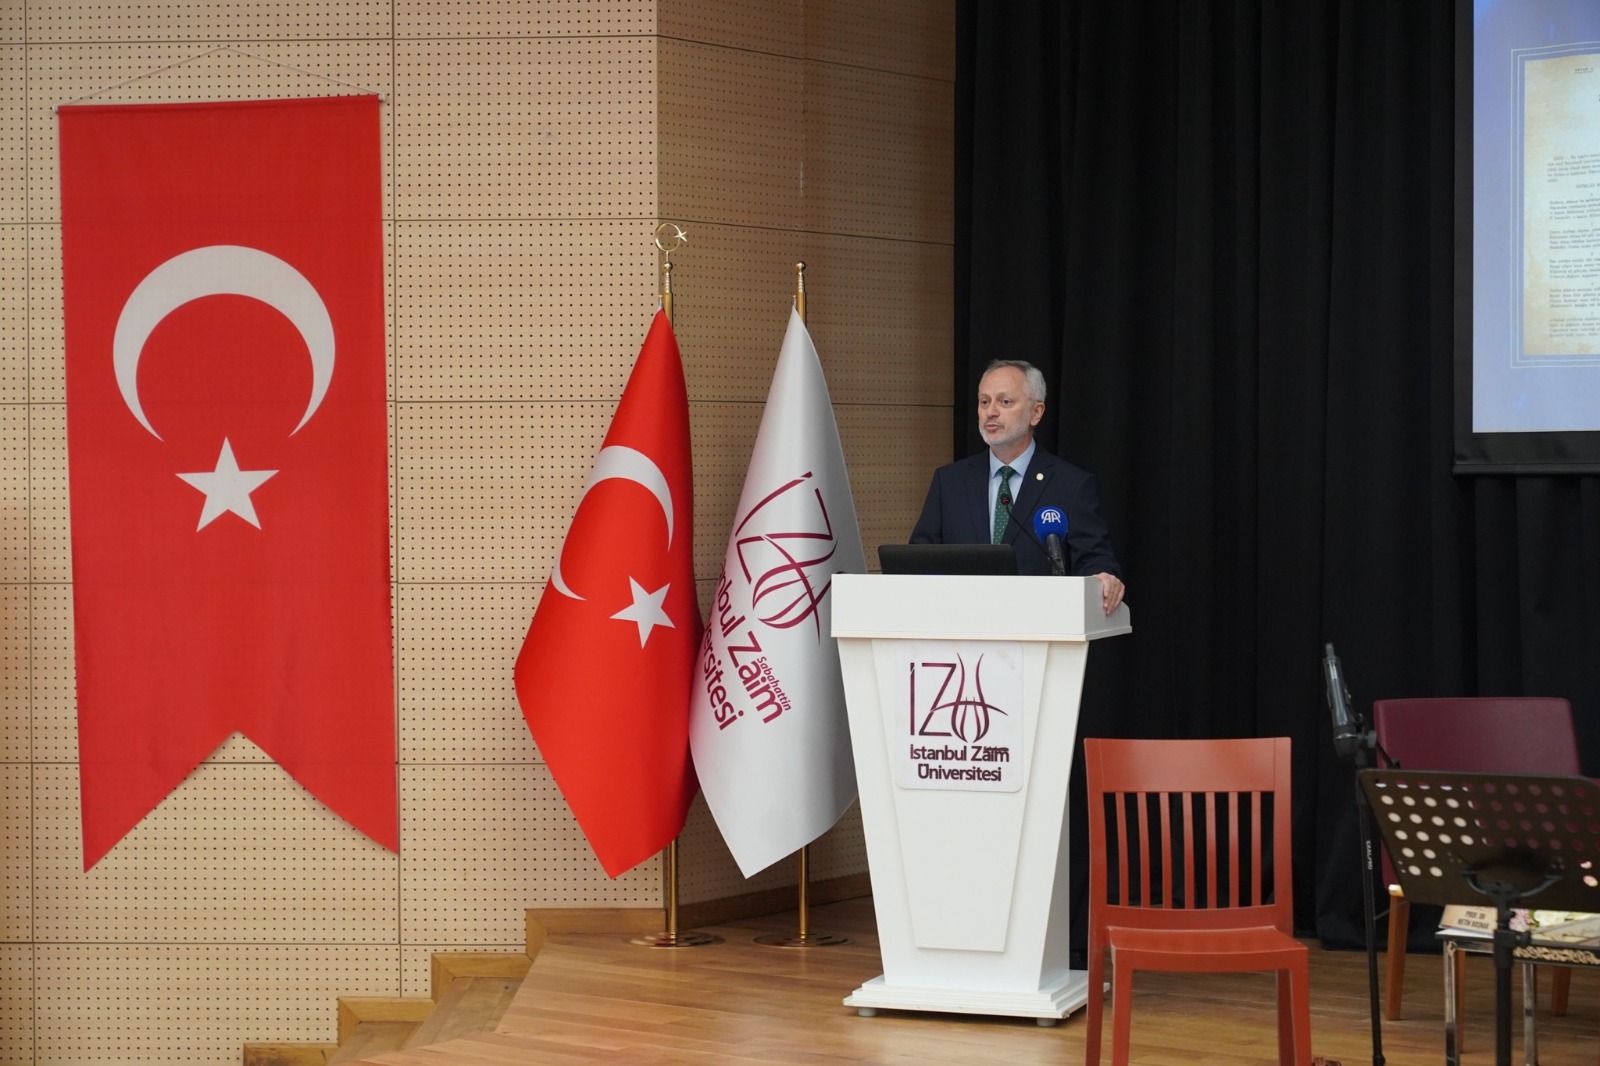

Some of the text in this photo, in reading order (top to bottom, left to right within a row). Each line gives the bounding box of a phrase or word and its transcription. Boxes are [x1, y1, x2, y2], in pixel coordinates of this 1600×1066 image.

[1041, 511, 1061, 524] AA
[727, 630, 784, 724] Zaim
[757, 656, 792, 711] Sabahattin
[910, 743, 1010, 762] İstanbul Zaim
[918, 763, 1002, 782] Üniversitesi
